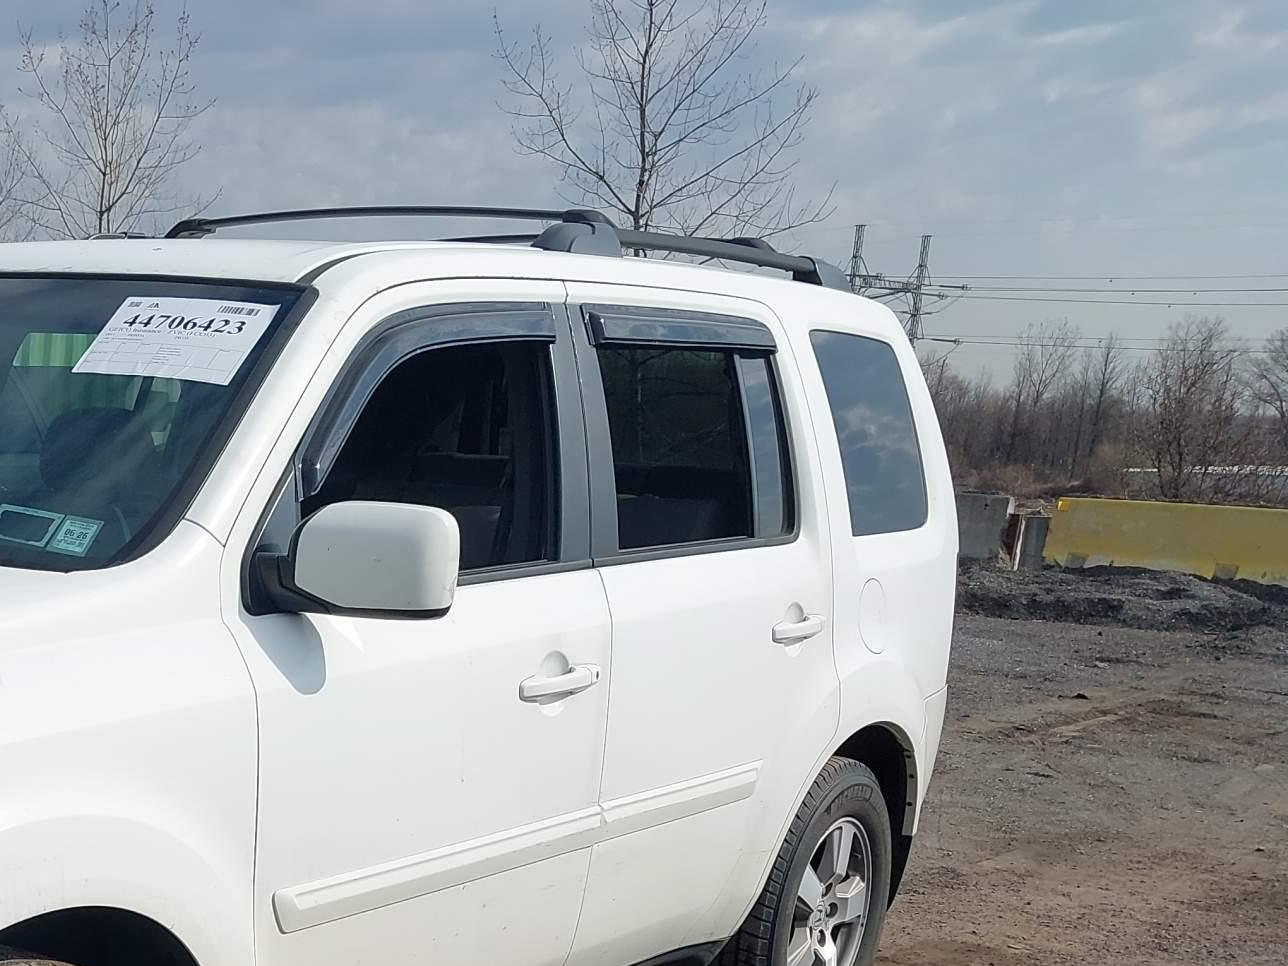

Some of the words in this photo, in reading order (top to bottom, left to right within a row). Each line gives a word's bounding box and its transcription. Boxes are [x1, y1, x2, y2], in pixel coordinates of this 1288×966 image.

[123, 313, 247, 334] 44706423
[64, 528, 76, 536] 06
[77, 531, 88, 539] 26
